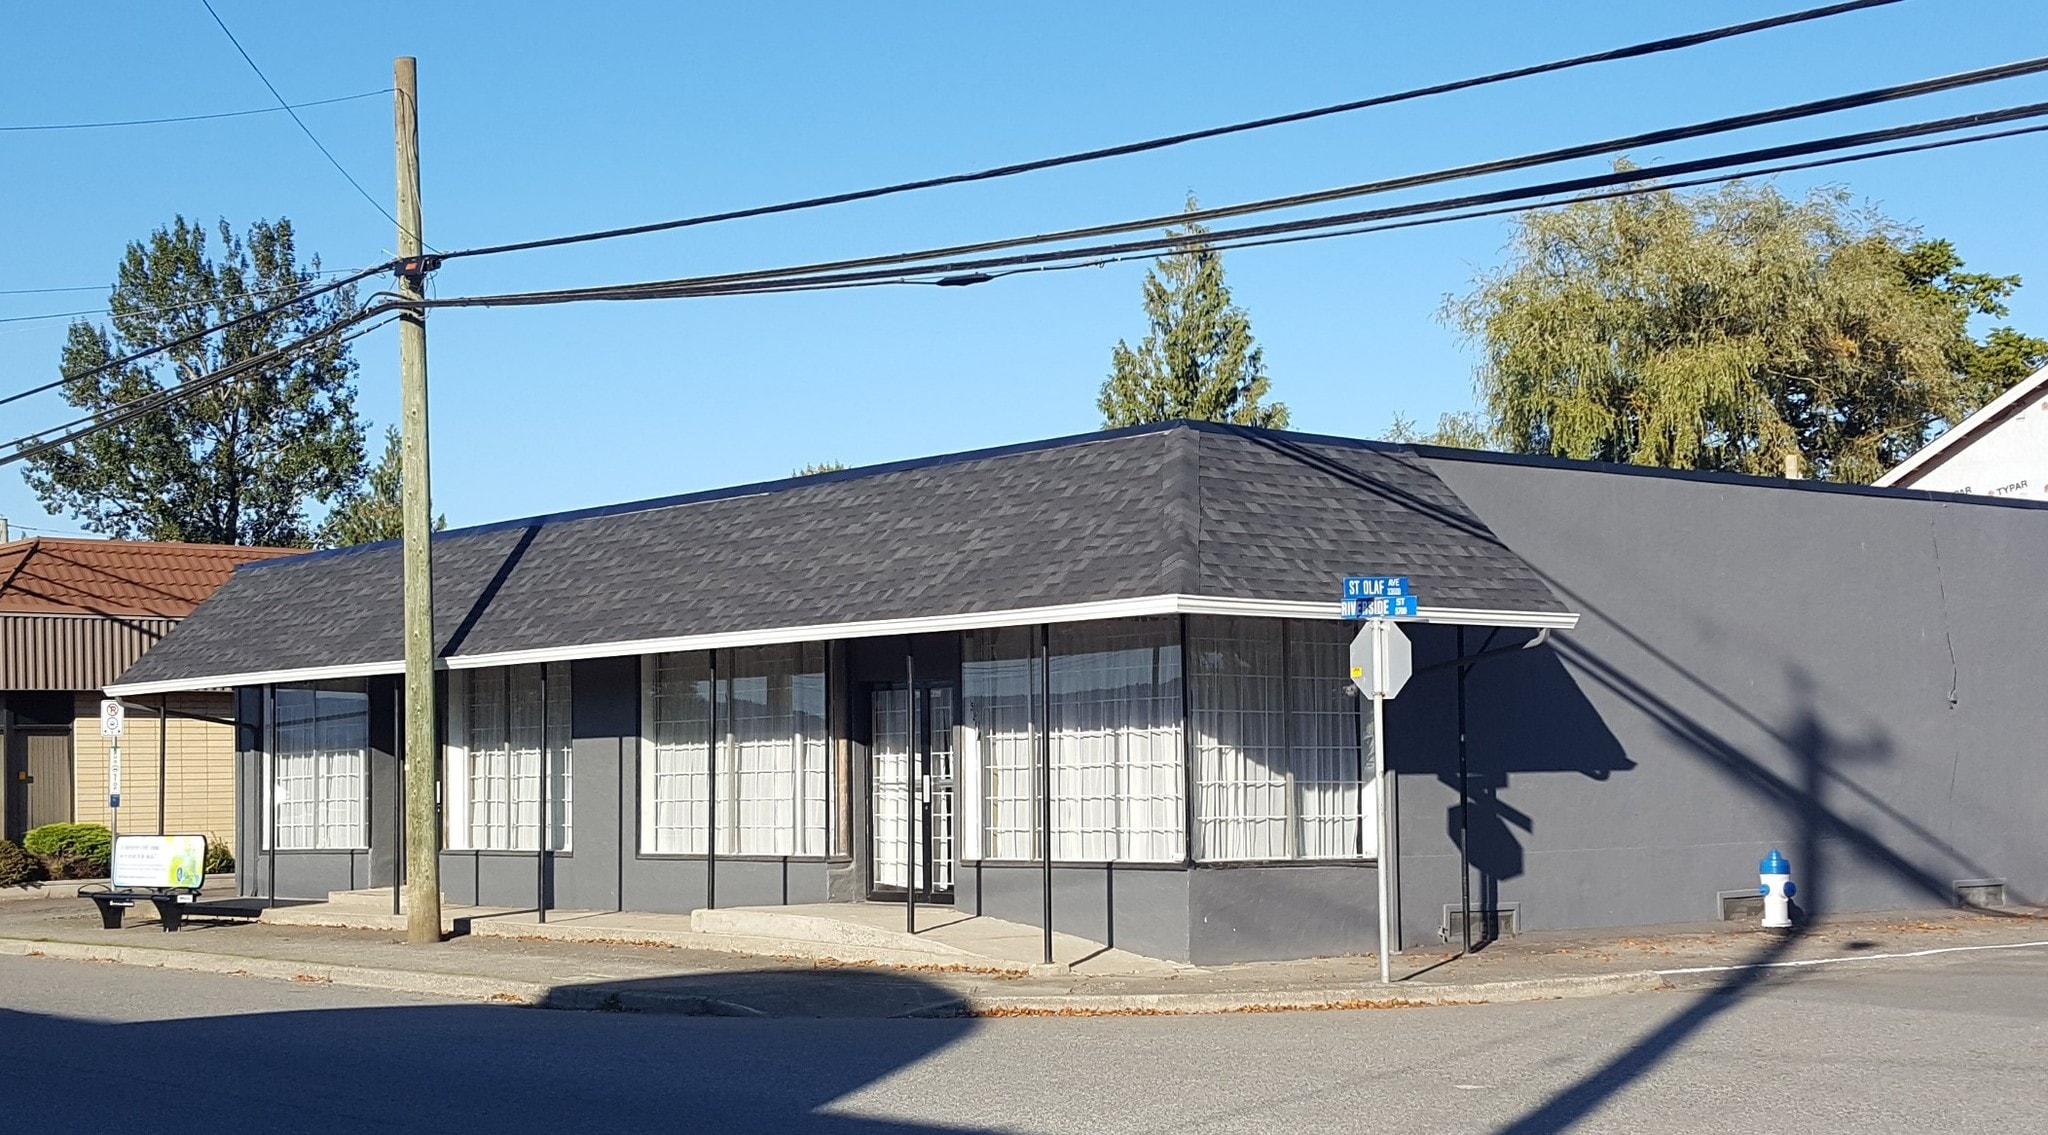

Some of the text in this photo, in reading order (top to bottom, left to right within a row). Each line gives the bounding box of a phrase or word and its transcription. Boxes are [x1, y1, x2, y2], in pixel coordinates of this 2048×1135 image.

[1996, 480, 2028, 496] TYPAR
[1349, 580, 1384, 594] ST OLAF
[1388, 579, 1400, 587] AVE
[1342, 600, 1389, 615] RIVERSIDE
[1396, 598, 1405, 606] ST
